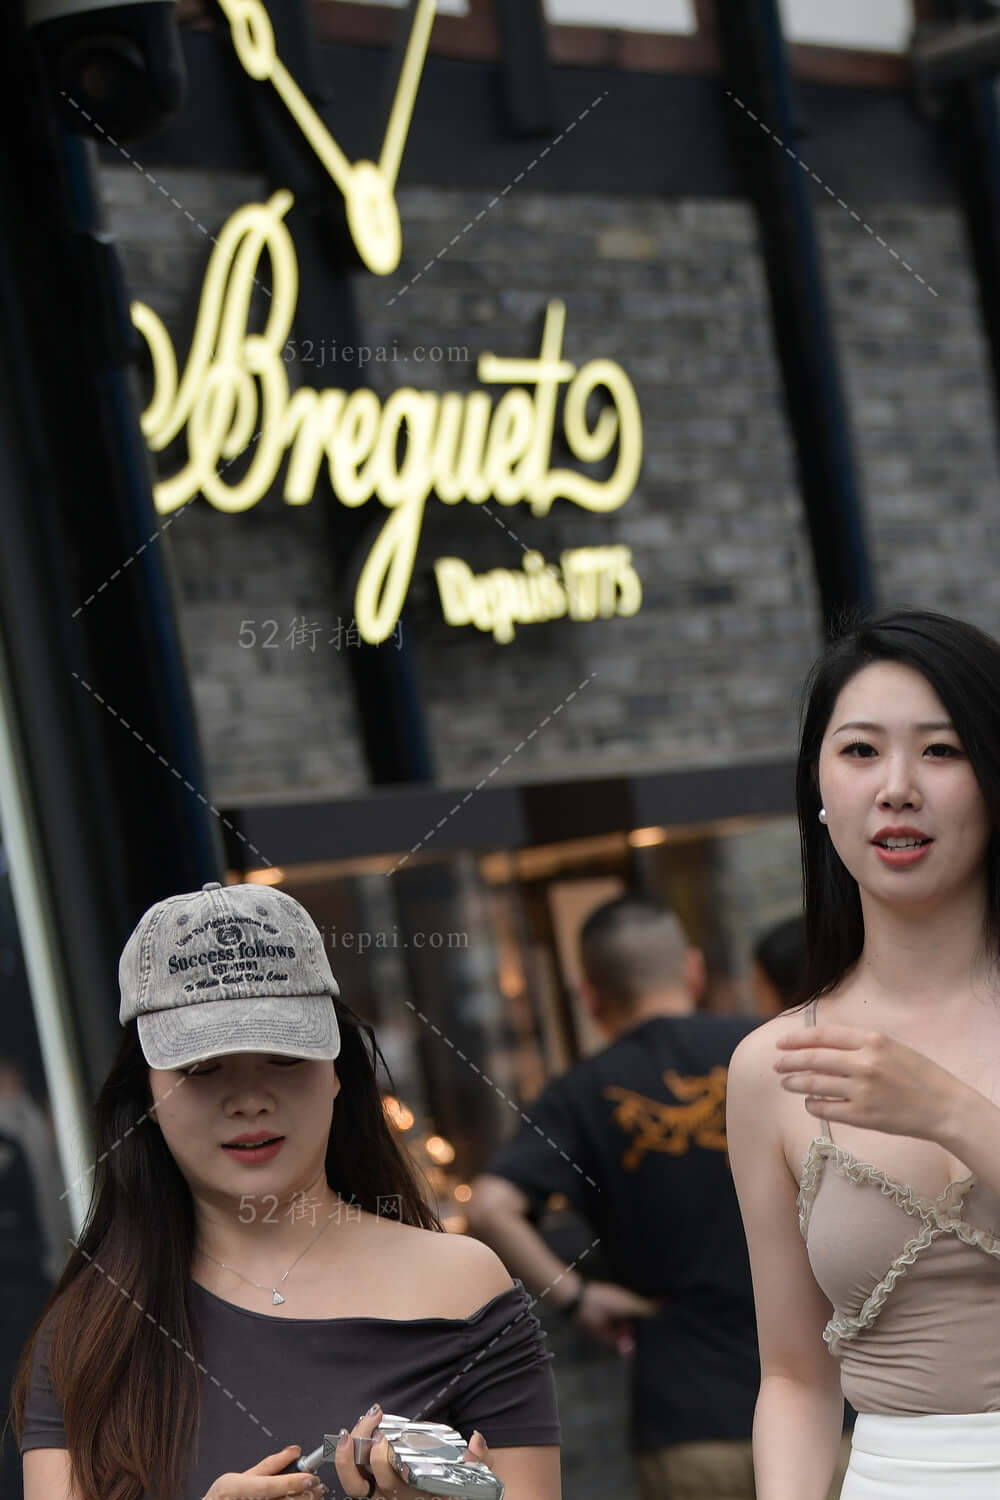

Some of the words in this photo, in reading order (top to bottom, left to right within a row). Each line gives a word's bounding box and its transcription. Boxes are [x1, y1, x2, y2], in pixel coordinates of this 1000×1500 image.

[131, 190, 642, 643] Breguet
[168, 948, 235, 975] Success
[239, 939, 296, 959] follows
